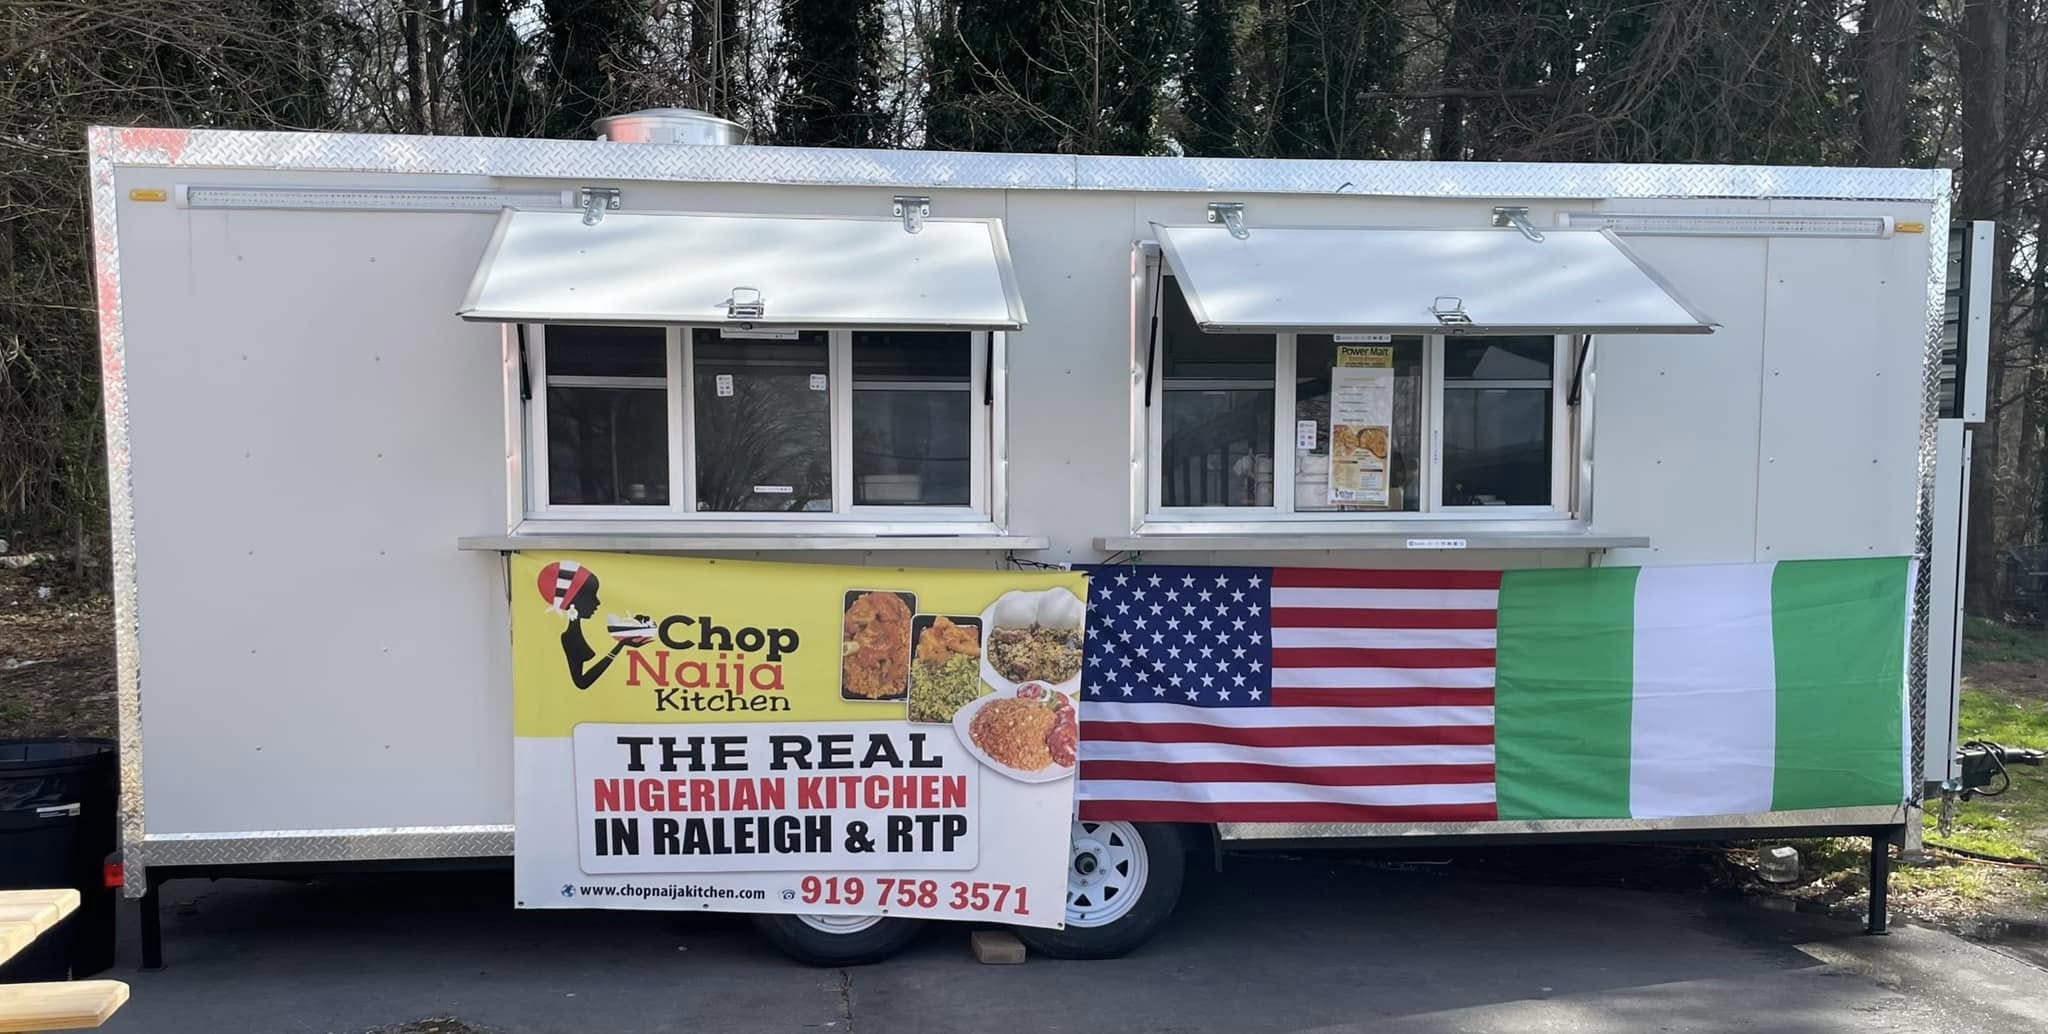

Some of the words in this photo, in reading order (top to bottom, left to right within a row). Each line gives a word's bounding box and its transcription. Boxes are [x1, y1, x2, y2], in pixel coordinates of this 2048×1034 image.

[658, 614, 800, 662] Chop
[626, 650, 785, 696] Naija
[654, 688, 792, 712] Kitchen
[617, 736, 749, 772] THE
[769, 733, 943, 771] REAL
[594, 777, 785, 812] NIGERIAN
[797, 775, 967, 810] KITCHEN
[595, 818, 639, 856] IN
[653, 815, 832, 855] RALEIGH
[844, 820, 876, 853] &
[887, 814, 968, 853] RTP
[580, 884, 766, 900] www.chopnaijakitchen.com
[801, 875, 865, 905] 919
[876, 878, 938, 909] 758
[949, 881, 1030, 916] 3571
